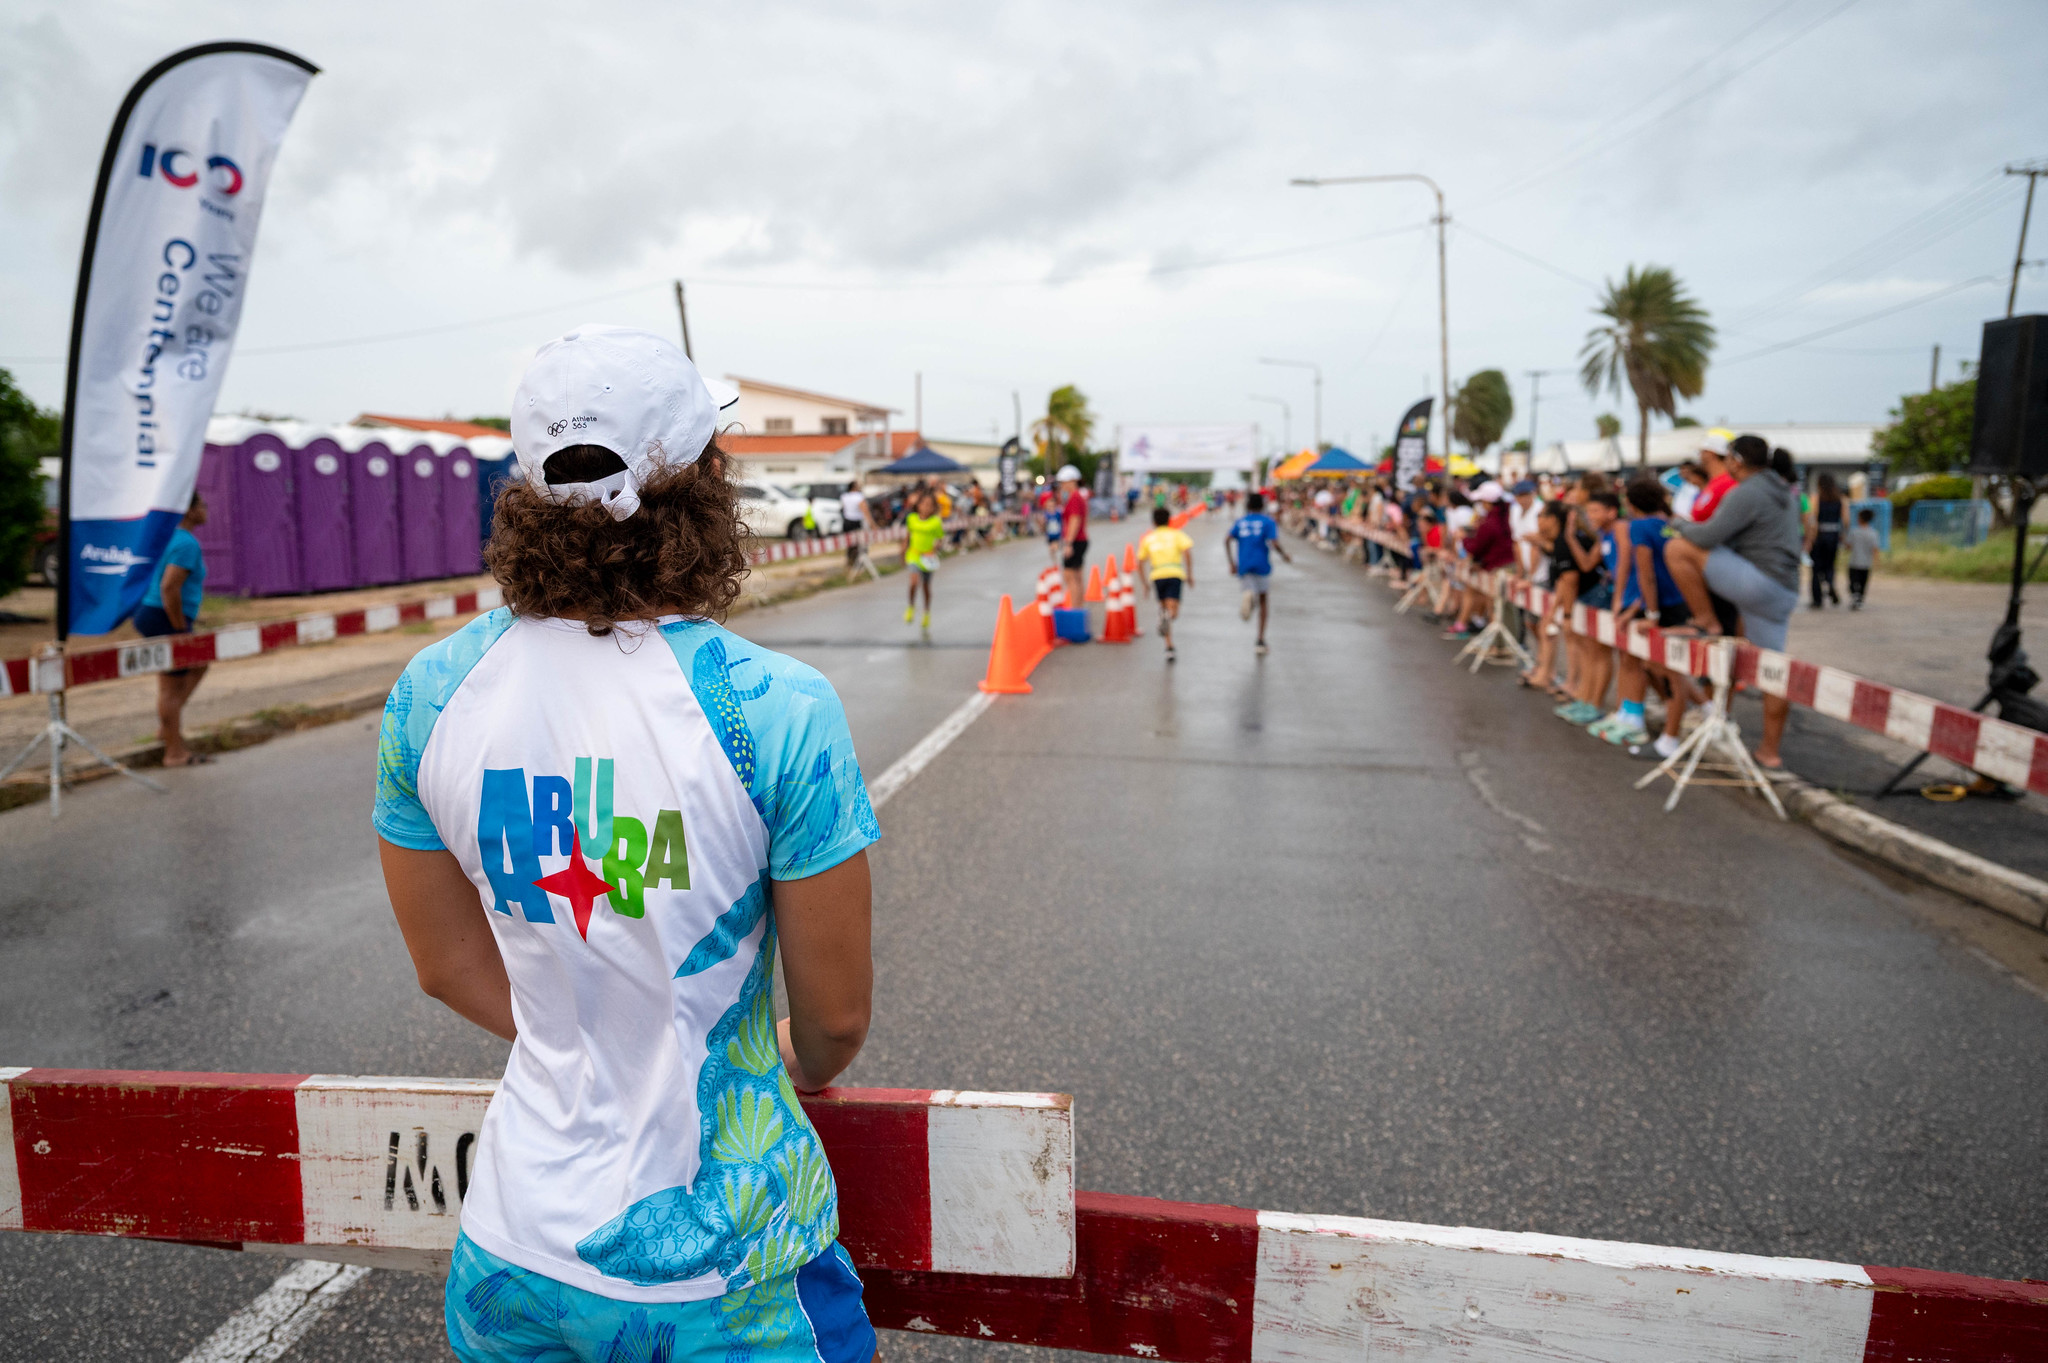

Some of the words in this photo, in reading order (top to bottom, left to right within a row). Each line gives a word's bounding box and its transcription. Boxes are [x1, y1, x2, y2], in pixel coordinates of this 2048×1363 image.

[195, 253, 241, 316] We
[136, 238, 197, 467] Centennial
[177, 324, 215, 381] are
[572, 422, 588, 430] 365
[477, 756, 691, 925] ARUBA
